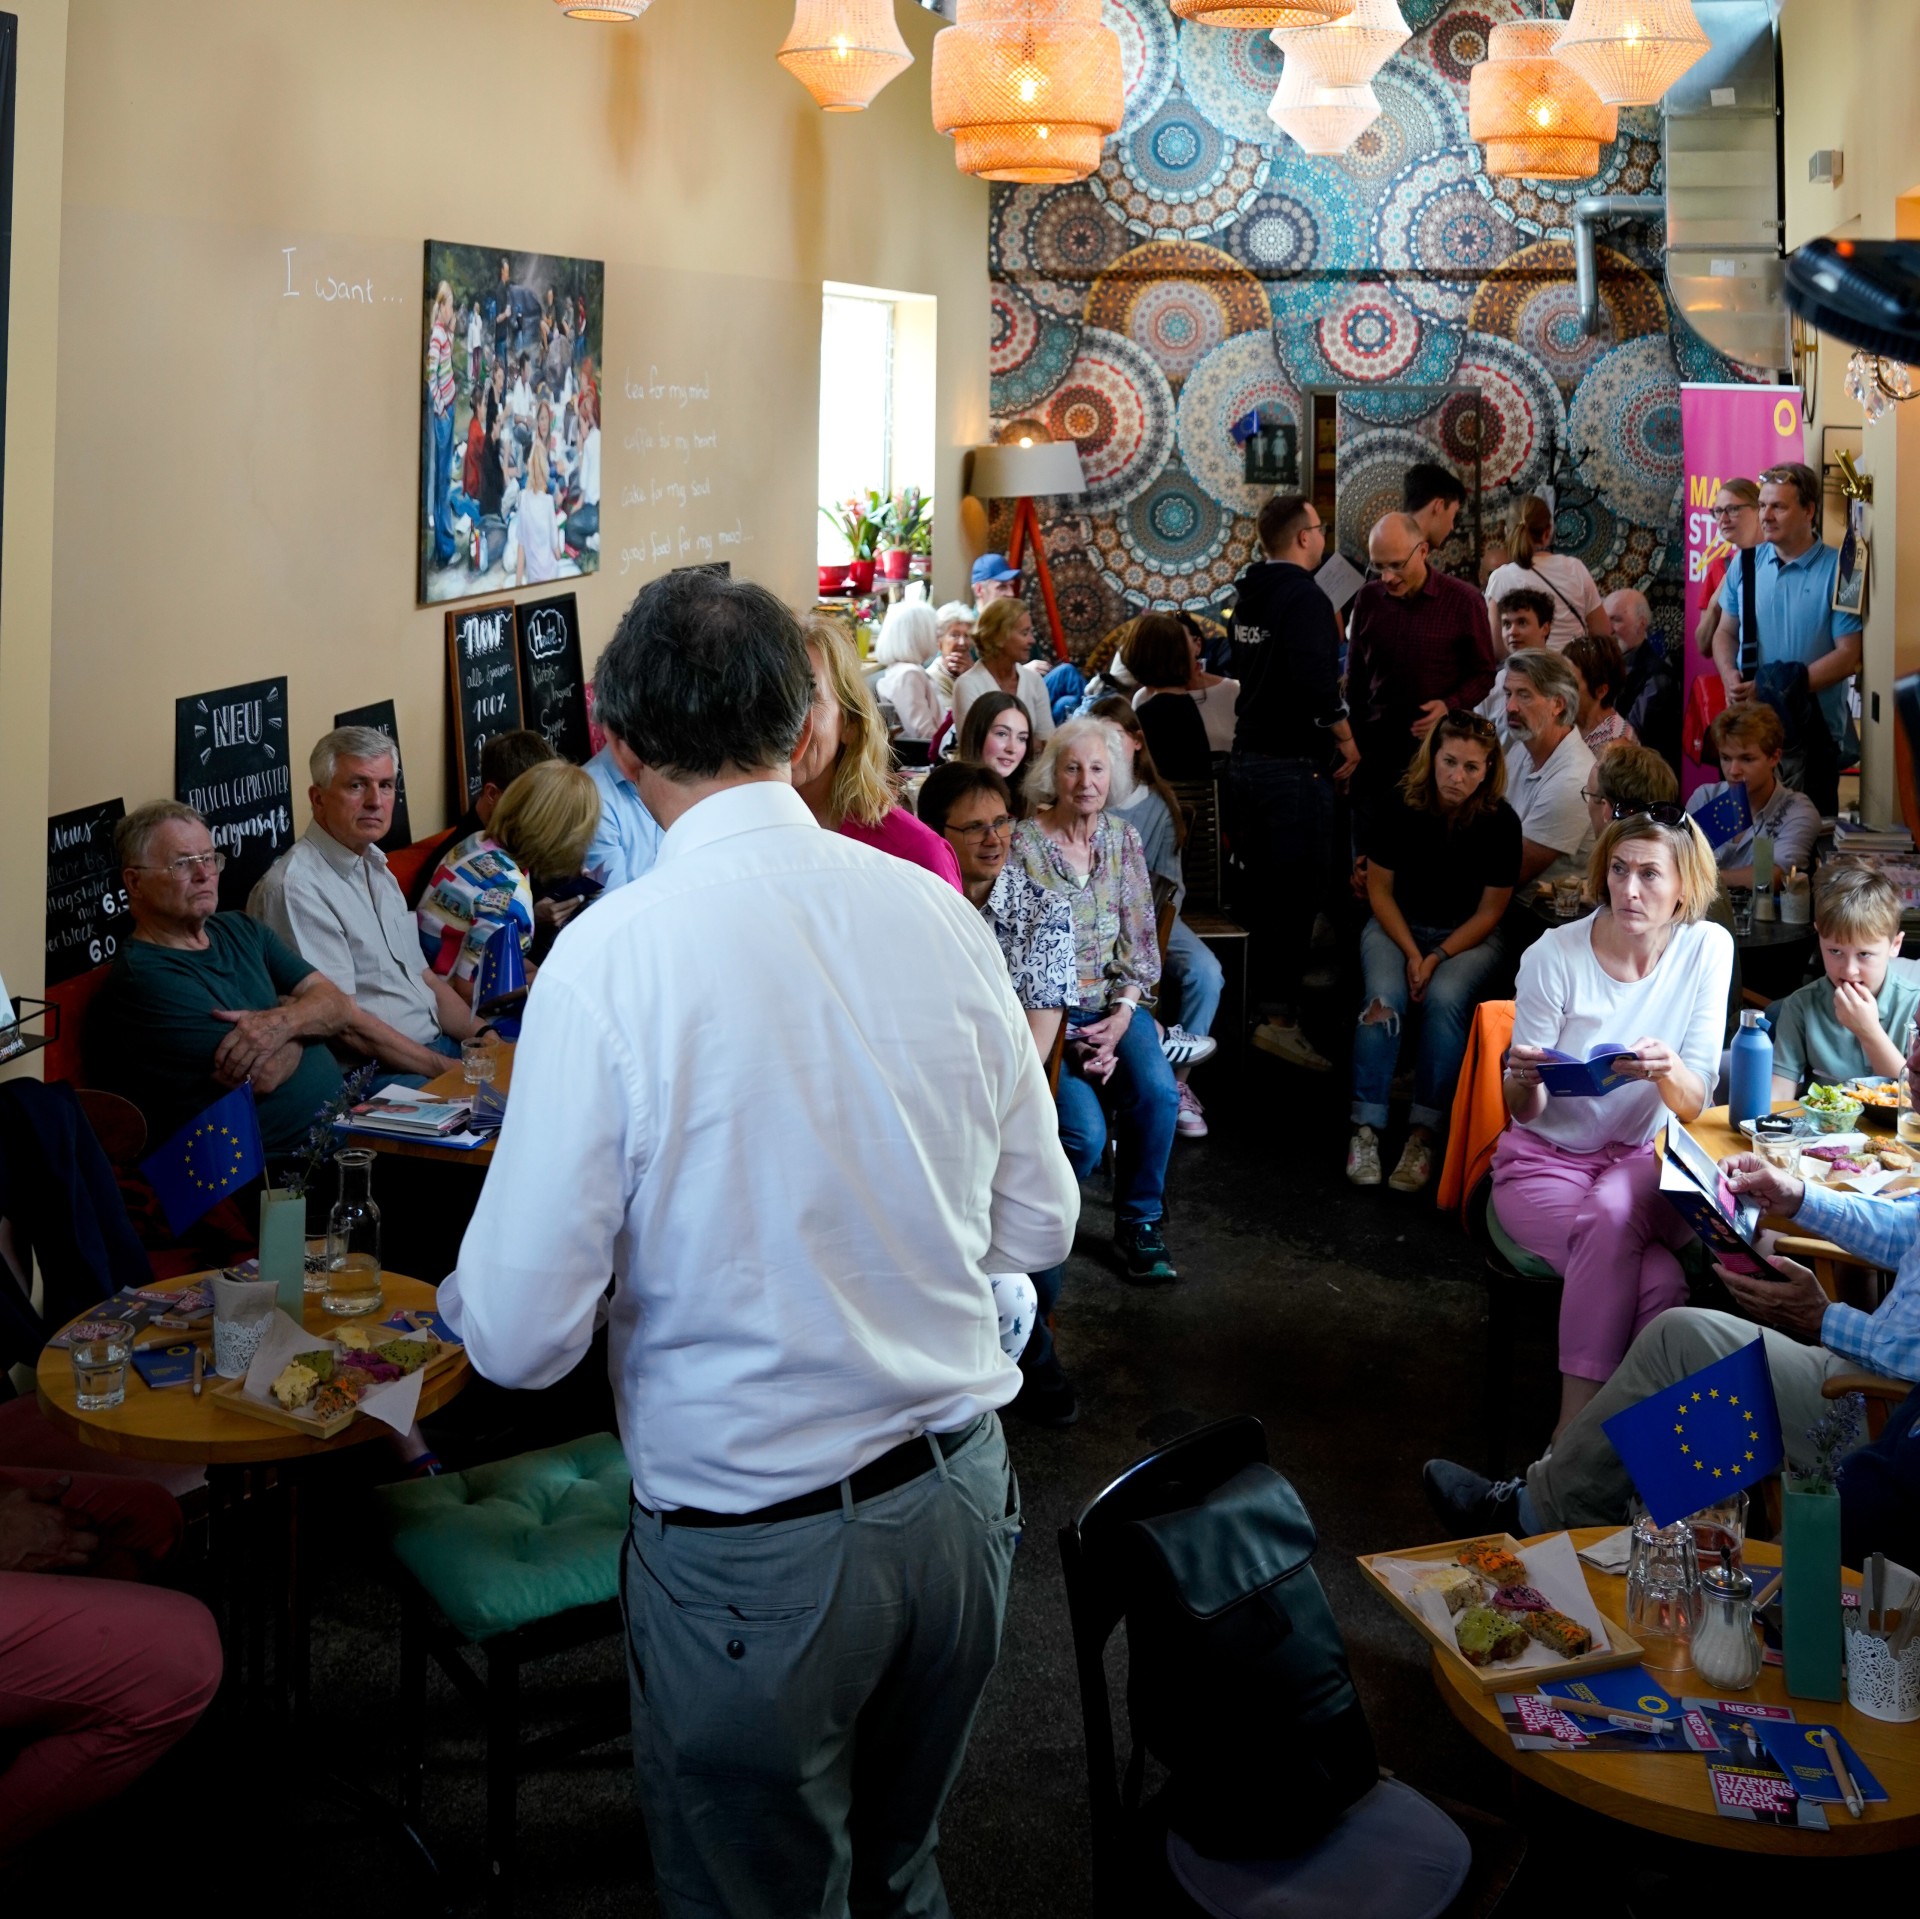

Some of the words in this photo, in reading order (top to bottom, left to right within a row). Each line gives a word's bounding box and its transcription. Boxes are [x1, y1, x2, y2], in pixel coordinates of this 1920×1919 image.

[281, 246, 300, 297] I
[625, 366, 645, 400] tea
[650, 364, 666, 400] for
[669, 383, 688, 409] my
[688, 370, 710, 400] mind
[674, 435, 690, 464] my
[650, 477, 663, 507] for
[666, 482, 687, 508] my
[690, 476, 711, 497] soul
[620, 538, 646, 576] good
[650, 530, 672, 565] food
[678, 525, 692, 560] for
[696, 533, 713, 560] my
[1234, 624, 1260, 644] NEOS
[472, 692, 507, 723] 100%
[213, 699, 263, 749] NEU
[233, 765, 289, 806] GEPRESSTER
[1515, 1696, 1541, 1732] MACHT.
[1686, 1712, 1709, 1737] NEOS
[1724, 1703, 1767, 1716] NEOS
[1718, 1780, 1757, 1793] WAS
[1759, 1785, 1796, 1798] UNS
[1720, 1788, 1776, 1802] STARK
[1722, 1795, 1788, 1812] MACHT.
